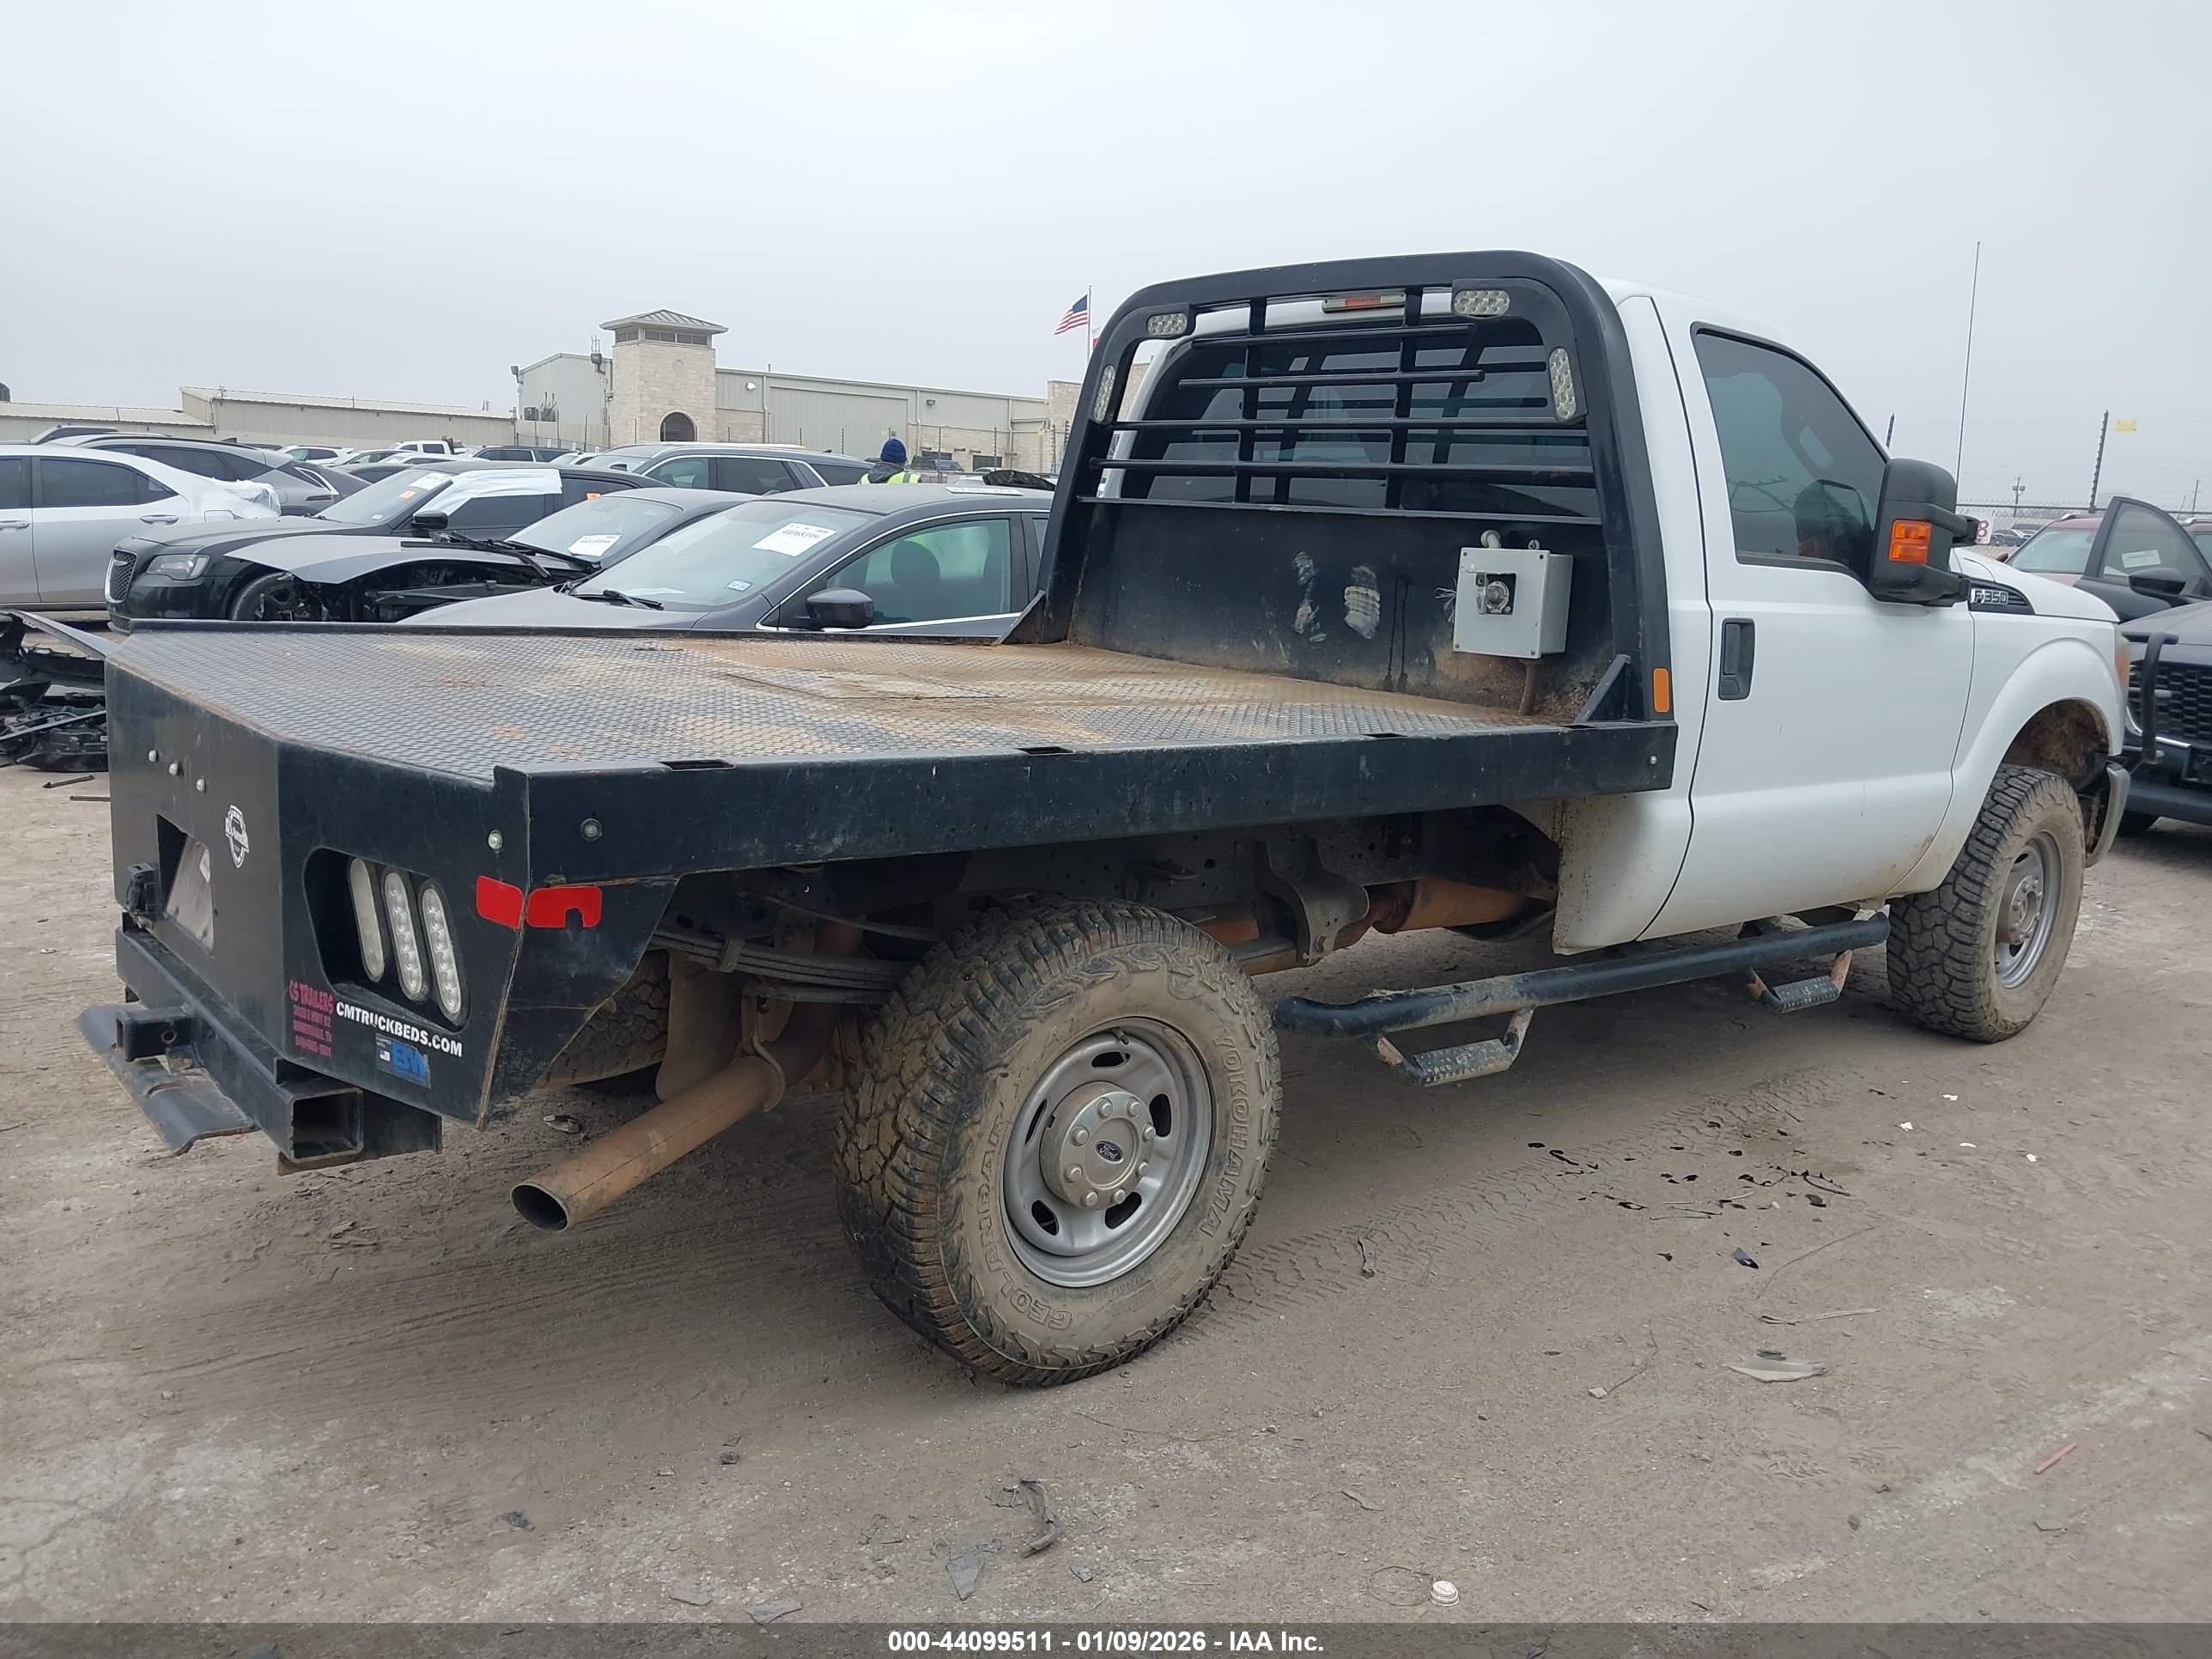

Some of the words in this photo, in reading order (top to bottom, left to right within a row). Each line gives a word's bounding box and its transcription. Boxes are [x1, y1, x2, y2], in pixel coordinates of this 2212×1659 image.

[299, 982, 334, 1015] TRAILERS
[336, 1001, 463, 1058] CMTRUCKBEDS.COM
[1099, 1144, 1119, 1160] Ford
[1198, 1027, 1250, 1238] YOKOHAMA
